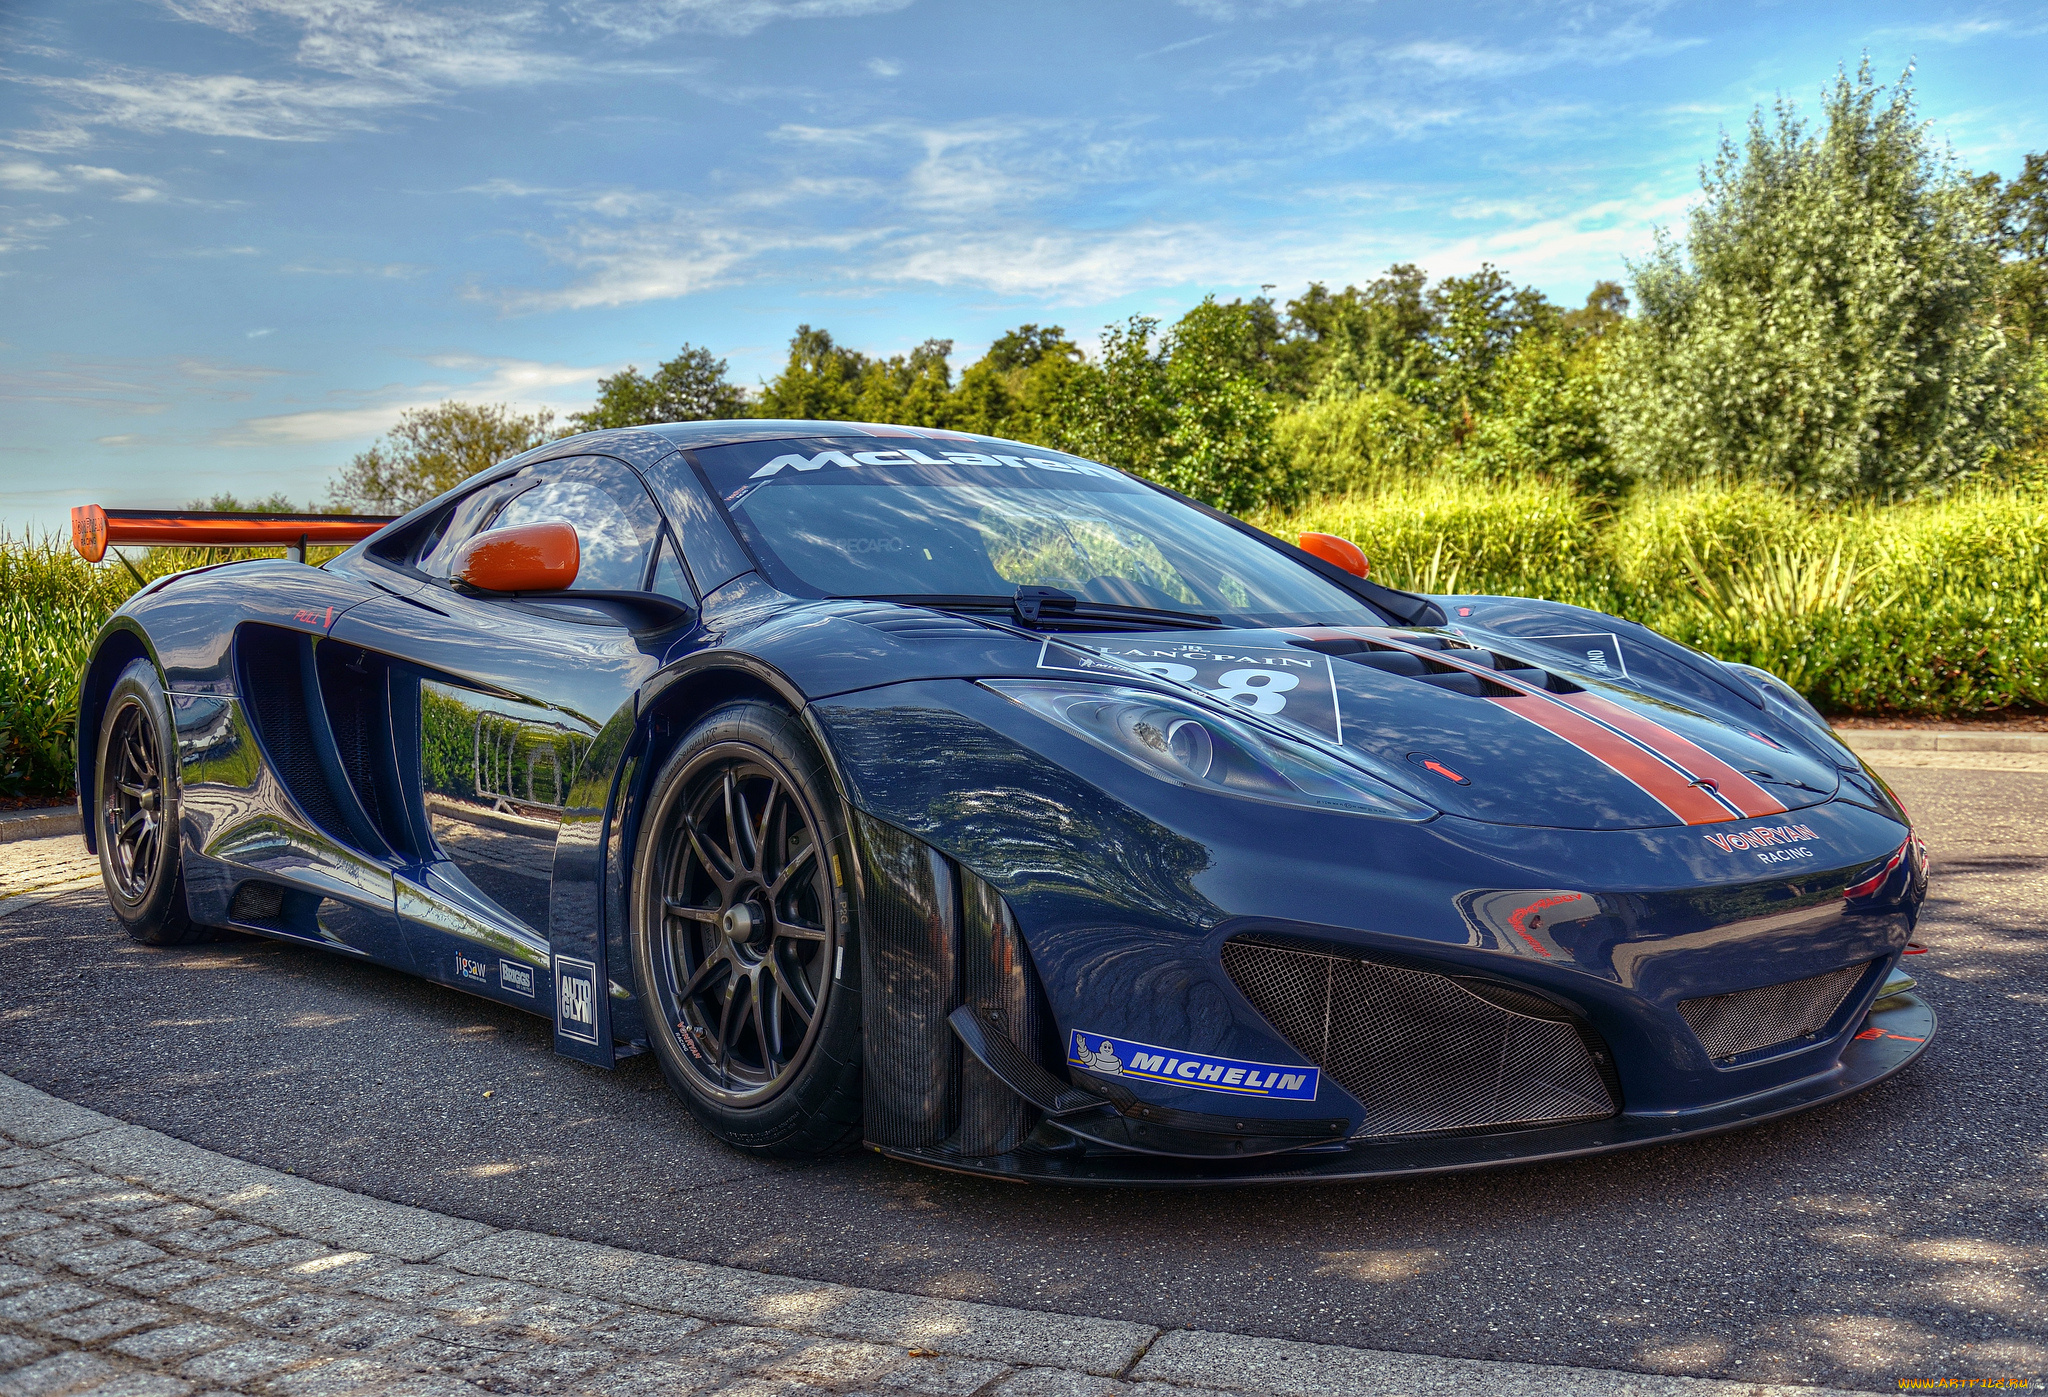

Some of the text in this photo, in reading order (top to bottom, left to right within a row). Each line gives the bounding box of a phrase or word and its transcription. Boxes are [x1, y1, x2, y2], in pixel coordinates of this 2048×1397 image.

[749, 449, 1125, 482] McLaren
[293, 610, 320, 625] PULL
[1085, 645, 1314, 668] LANCPAIN
[1703, 824, 1820, 853] VONRYAN
[1757, 847, 1814, 865] RACING
[455, 951, 486, 978] jigsaw
[502, 964, 531, 988] BRIGGS
[562, 976, 591, 1003] AUTO
[1130, 1052, 1306, 1091] MICHELIN
